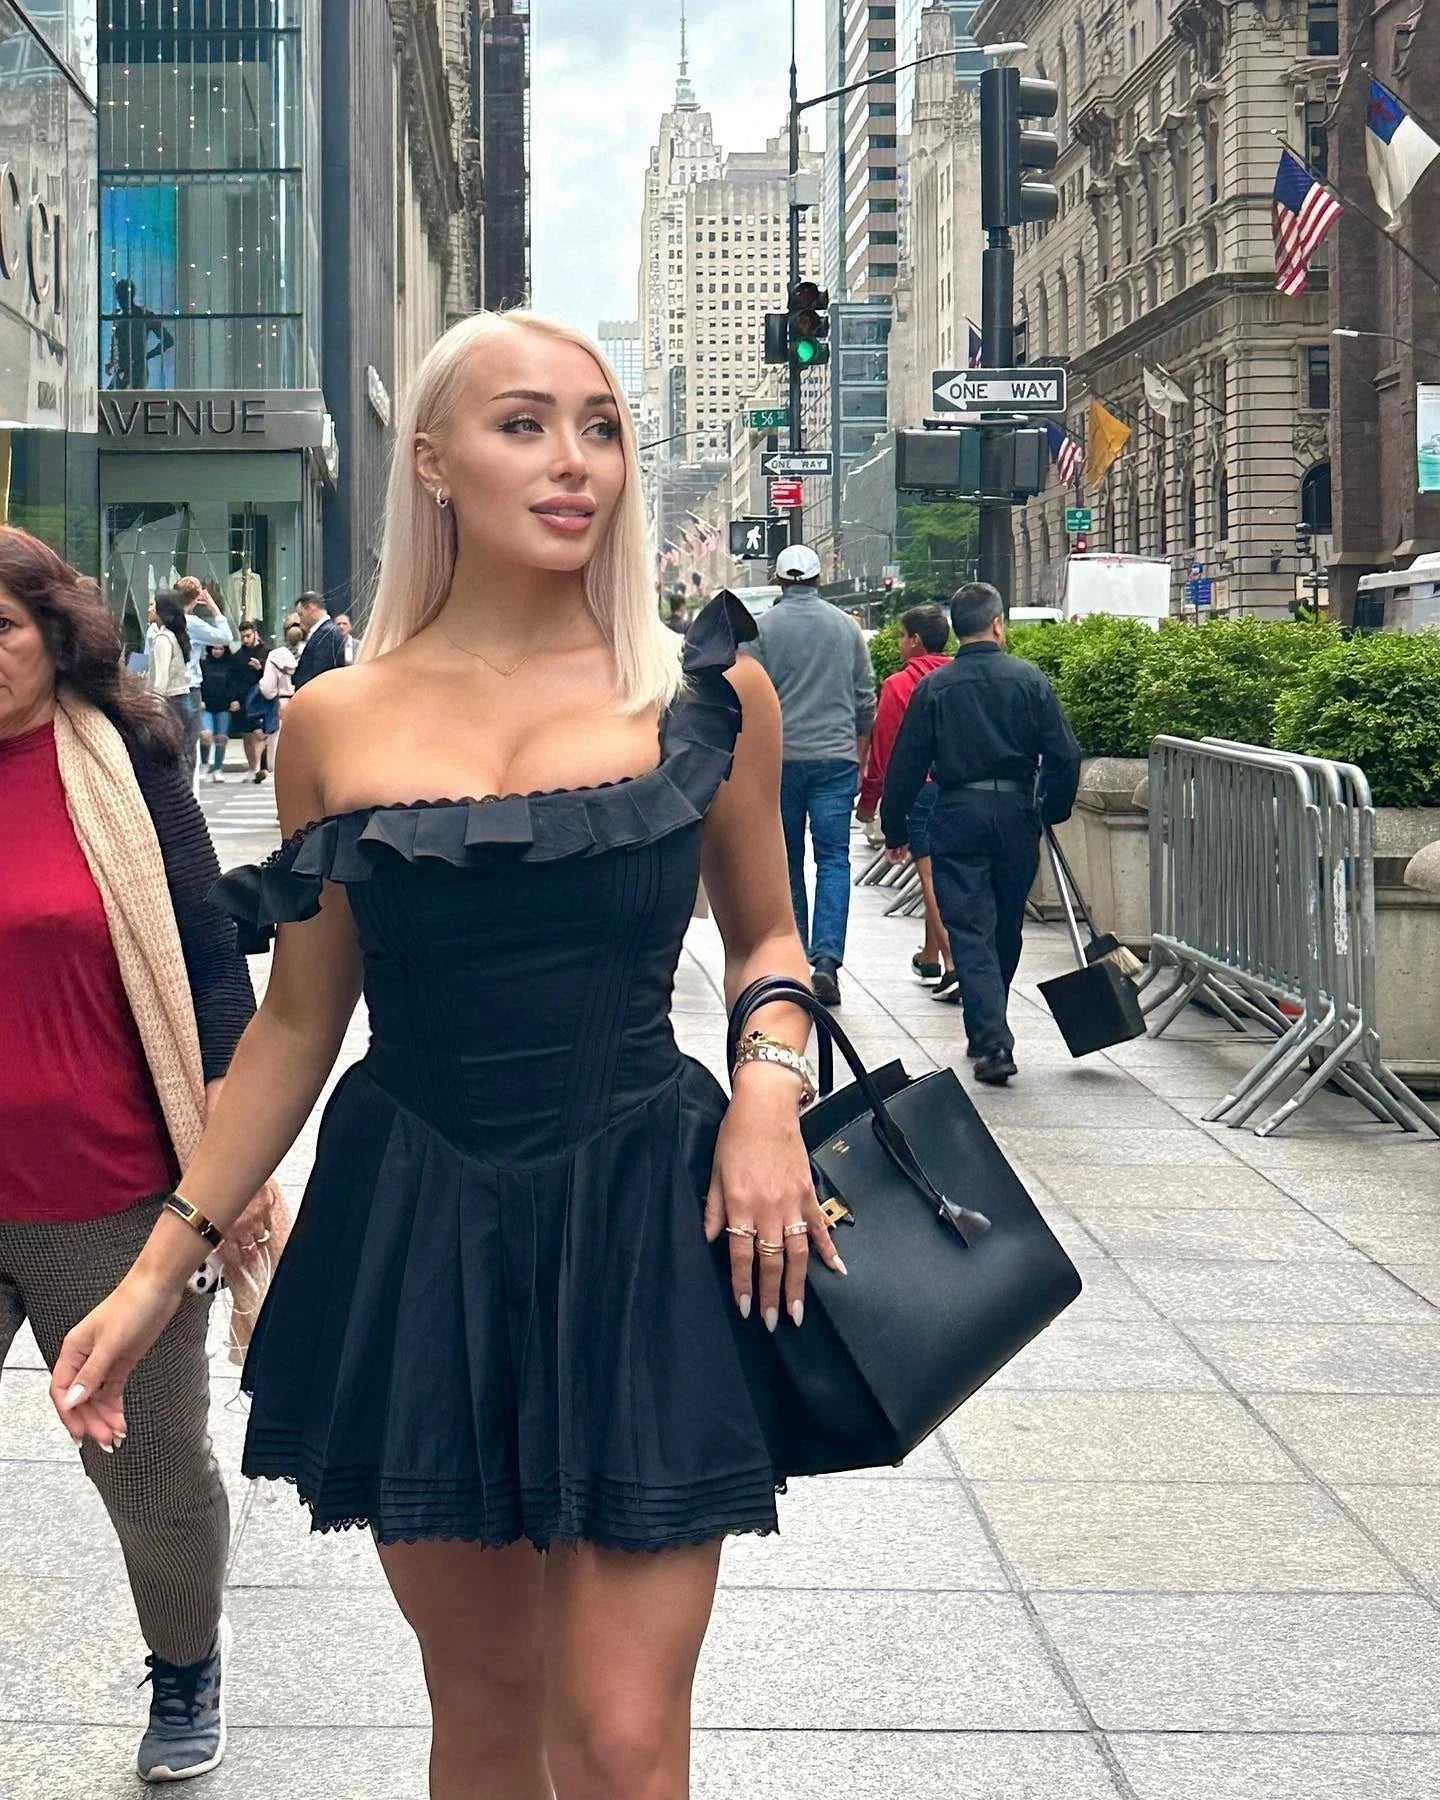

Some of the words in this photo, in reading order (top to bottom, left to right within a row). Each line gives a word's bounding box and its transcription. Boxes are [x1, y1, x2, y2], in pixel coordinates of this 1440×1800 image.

[949, 383, 988, 399] ONE
[1011, 382, 1052, 398] WAY
[761, 411, 774, 426] 56
[771, 460, 792, 469] ONE
[801, 460, 824, 469] WAY
